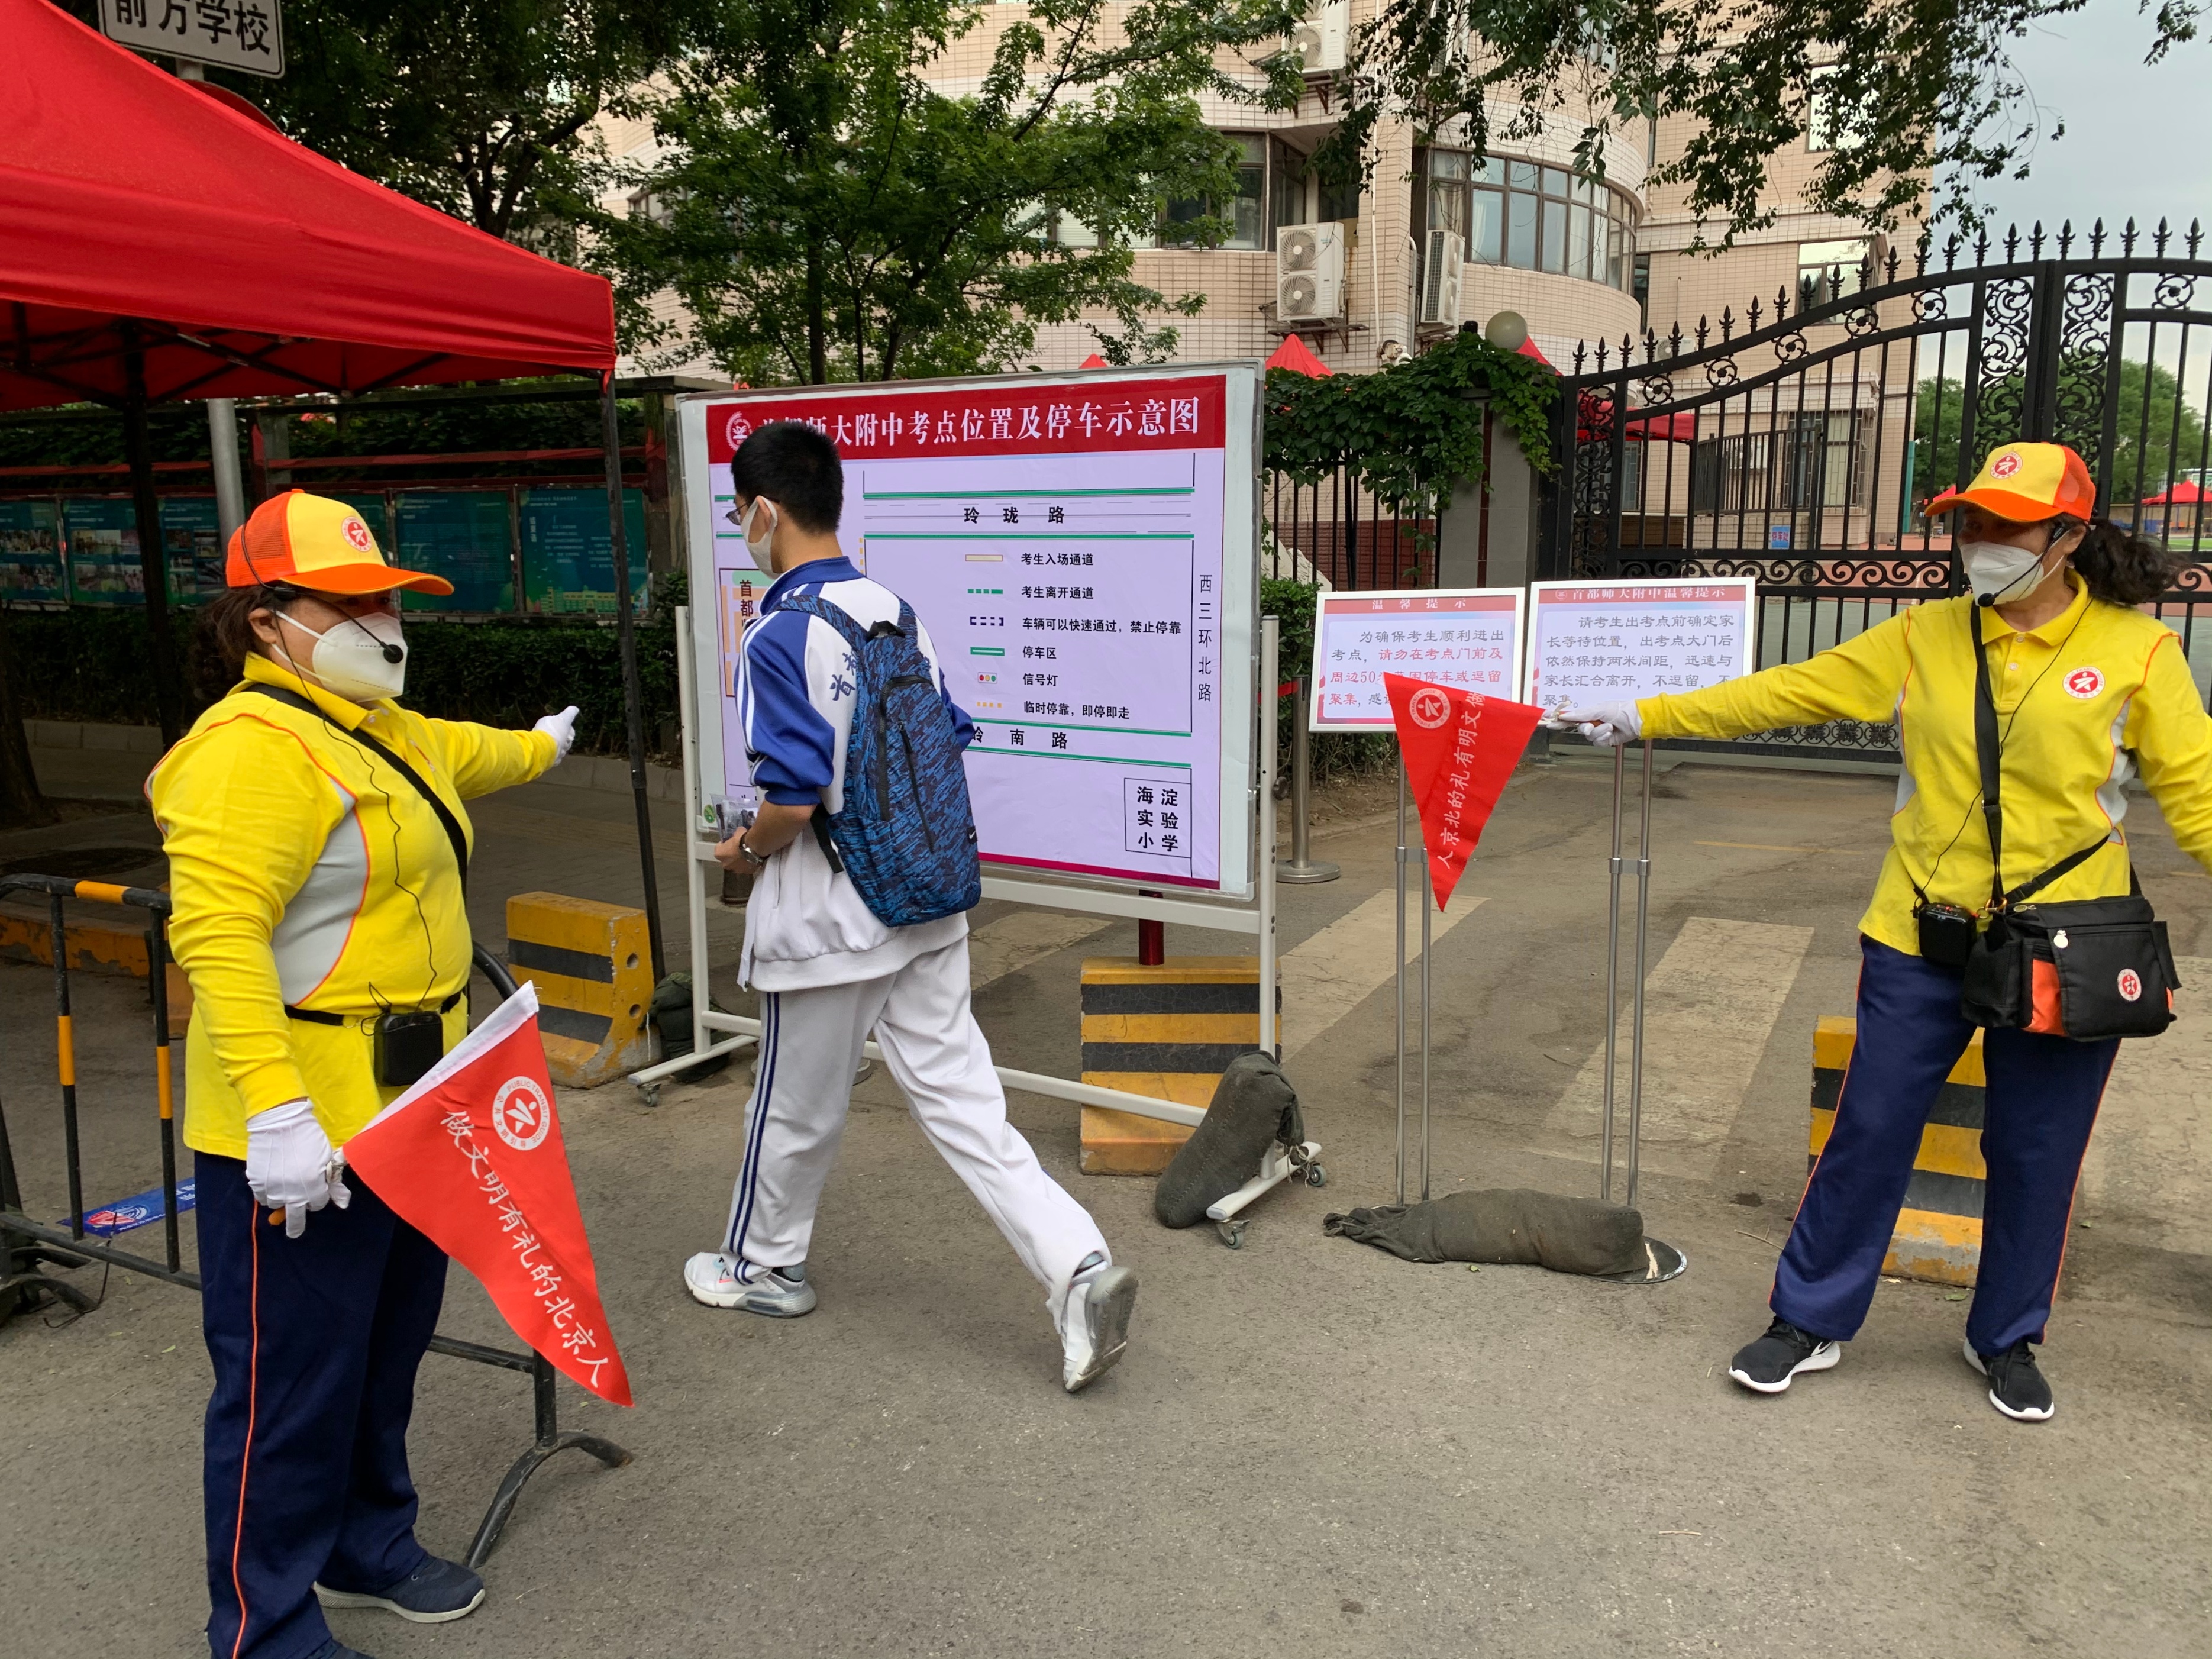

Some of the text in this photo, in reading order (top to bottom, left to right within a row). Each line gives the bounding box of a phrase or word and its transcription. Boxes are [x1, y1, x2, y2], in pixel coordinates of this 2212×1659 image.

[117, 0, 270, 55] 前方学校
[759, 396, 1199, 447] 师大附中考点位置及停车示意图
[964, 506, 1064, 524] 玲珑路
[1021, 553, 1094, 566] 考生入场通道
[1021, 586, 1094, 600] 考生离开通道
[1572, 586, 1726, 600] 首都师大附中温馨提示
[740, 579, 754, 627] 首都
[1372, 598, 1466, 610] 温馨提示
[1578, 615, 1735, 628] 请考生出考点前确定家
[1198, 574, 1213, 702] 西三环北路
[1359, 630, 1504, 643] 为确保考生顺利进出
[1023, 646, 1057, 659] 停车区
[1023, 673, 1058, 686] 信号灯
[507, 1080, 548, 1143] PUBLIC TRANSIT GUIDE
[440, 1110, 609, 1389] 做文明有礼的北京人
